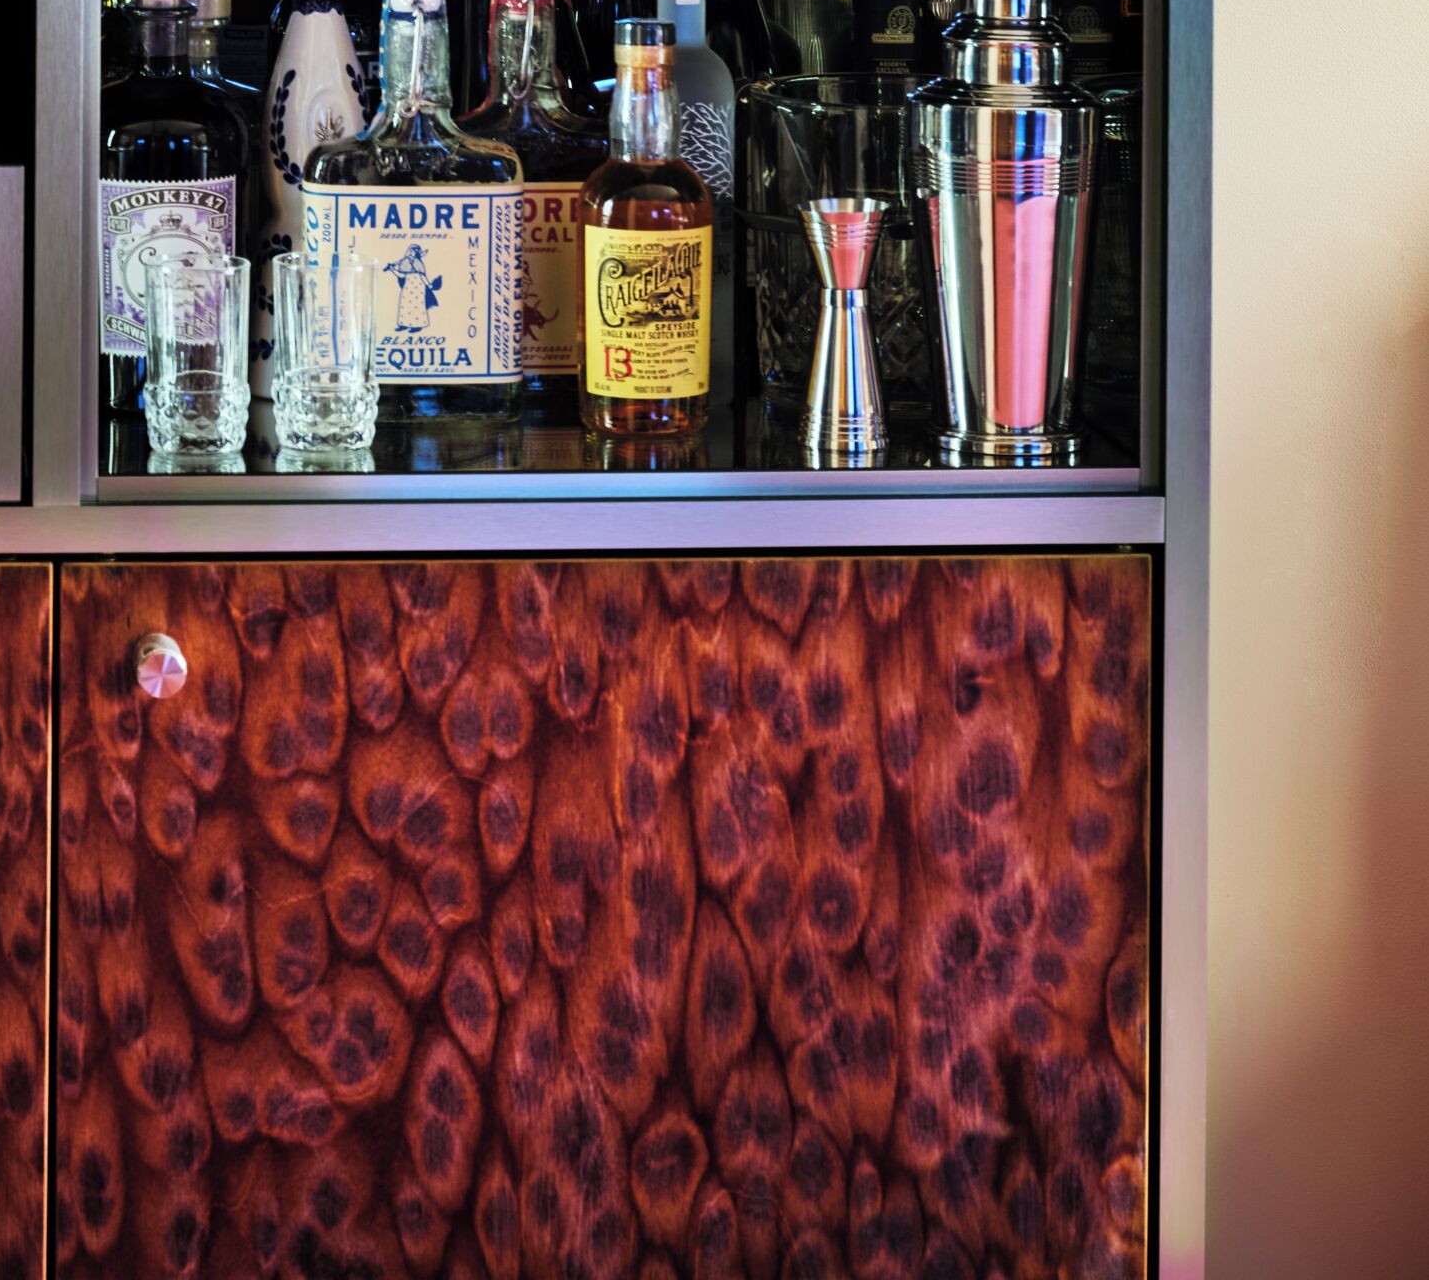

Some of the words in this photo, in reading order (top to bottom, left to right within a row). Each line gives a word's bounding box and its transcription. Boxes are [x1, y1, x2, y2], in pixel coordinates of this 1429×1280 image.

[114, 190, 204, 214] MONKEY
[205, 195, 224, 210] 47
[349, 203, 480, 229] MADRE
[503, 201, 511, 257] ALTOS
[322, 223, 332, 243] 200
[494, 205, 503, 266] PREDIO
[514, 198, 523, 271] MEXICO
[467, 236, 479, 339] MEXICO
[494, 271, 502, 296] DE
[502, 263, 511, 291] LOS
[513, 277, 522, 301] EN
[598, 241, 702, 328] CRAIGELLACHIE
[502, 297, 510, 317] DE
[493, 302, 502, 361] AGAVE
[513, 309, 522, 369] HECHO
[601, 329, 623, 339] SINGLE
[626, 331, 646, 339] MALT
[648, 330, 674, 340] SCOTCH
[677, 328, 700, 338] WHISKY
[655, 321, 696, 331] SPEYSIDE
[380, 336, 447, 345] BLANCO
[604, 345, 633, 381] 13
